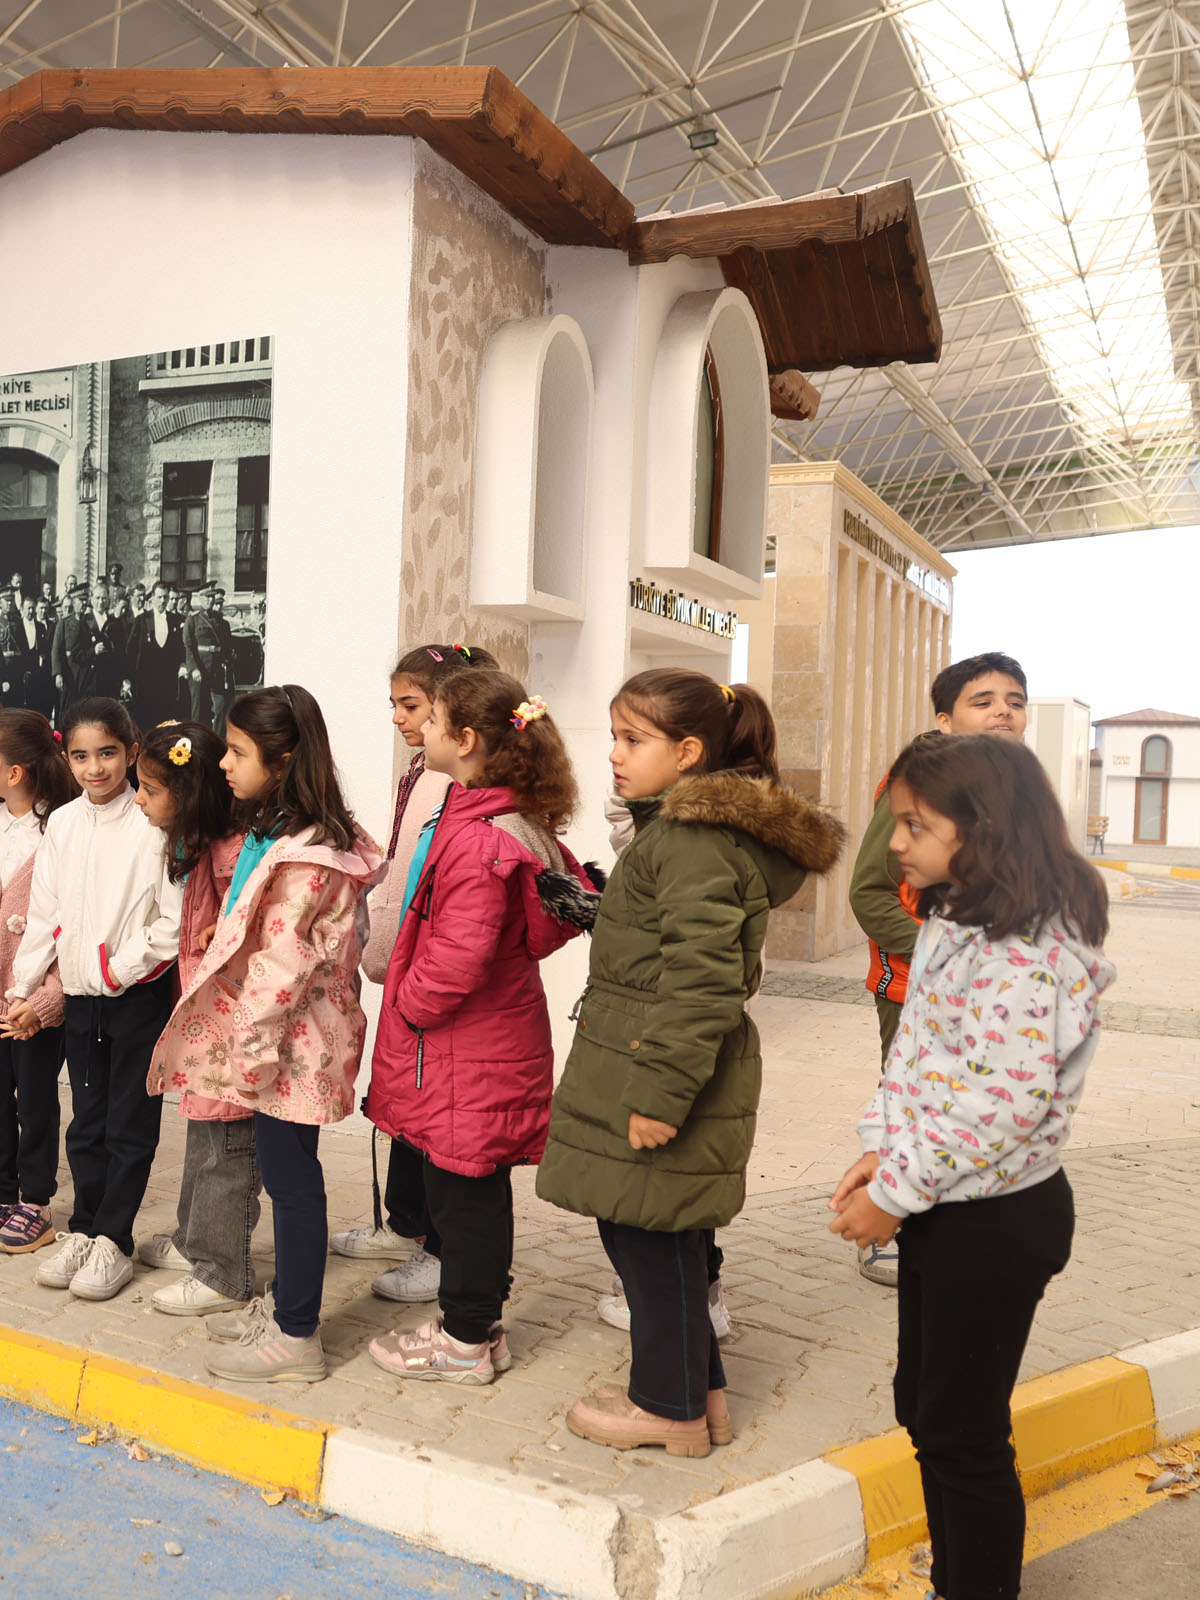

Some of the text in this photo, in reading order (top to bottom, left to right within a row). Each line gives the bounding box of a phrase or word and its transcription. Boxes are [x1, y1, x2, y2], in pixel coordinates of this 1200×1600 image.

[25, 394, 70, 412] MECLİSİ
[629, 577, 666, 617] TÜRKİYE
[666, 589, 691, 625] BÜYÜK
[691, 599, 715, 633] MİLLET
